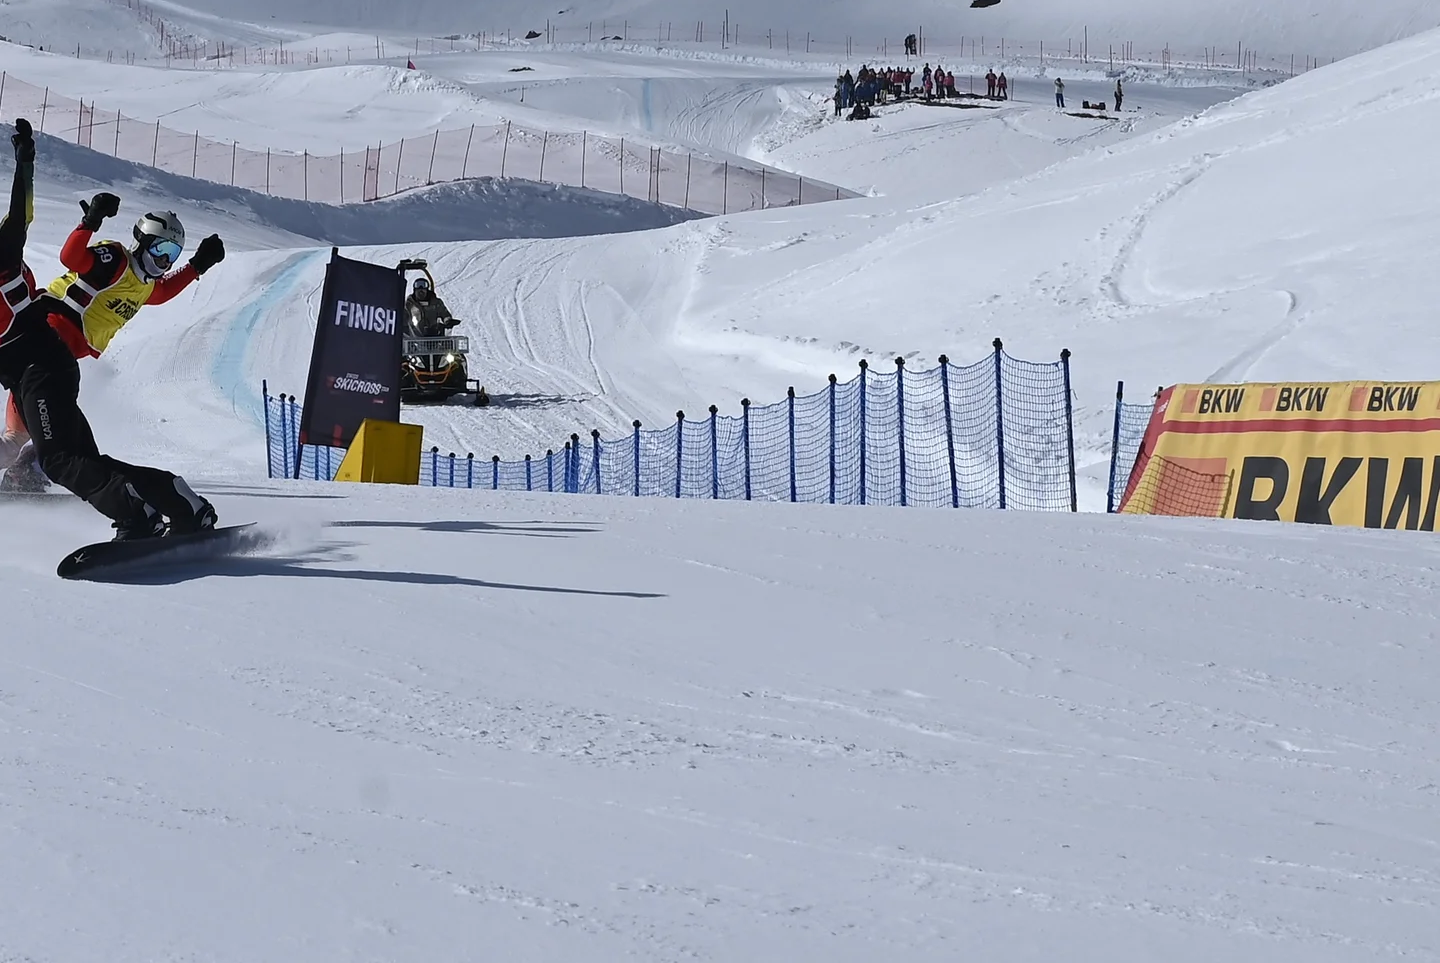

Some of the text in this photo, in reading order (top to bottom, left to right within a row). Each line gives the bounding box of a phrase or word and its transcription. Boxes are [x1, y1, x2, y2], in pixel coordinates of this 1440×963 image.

[334, 300, 397, 336] FINISH
[333, 377, 382, 396] SKICROSS
[1198, 388, 1245, 414] BKW
[1275, 387, 1330, 412] BKW
[1366, 386, 1421, 412] BKW
[36, 398, 53, 441] KARBON
